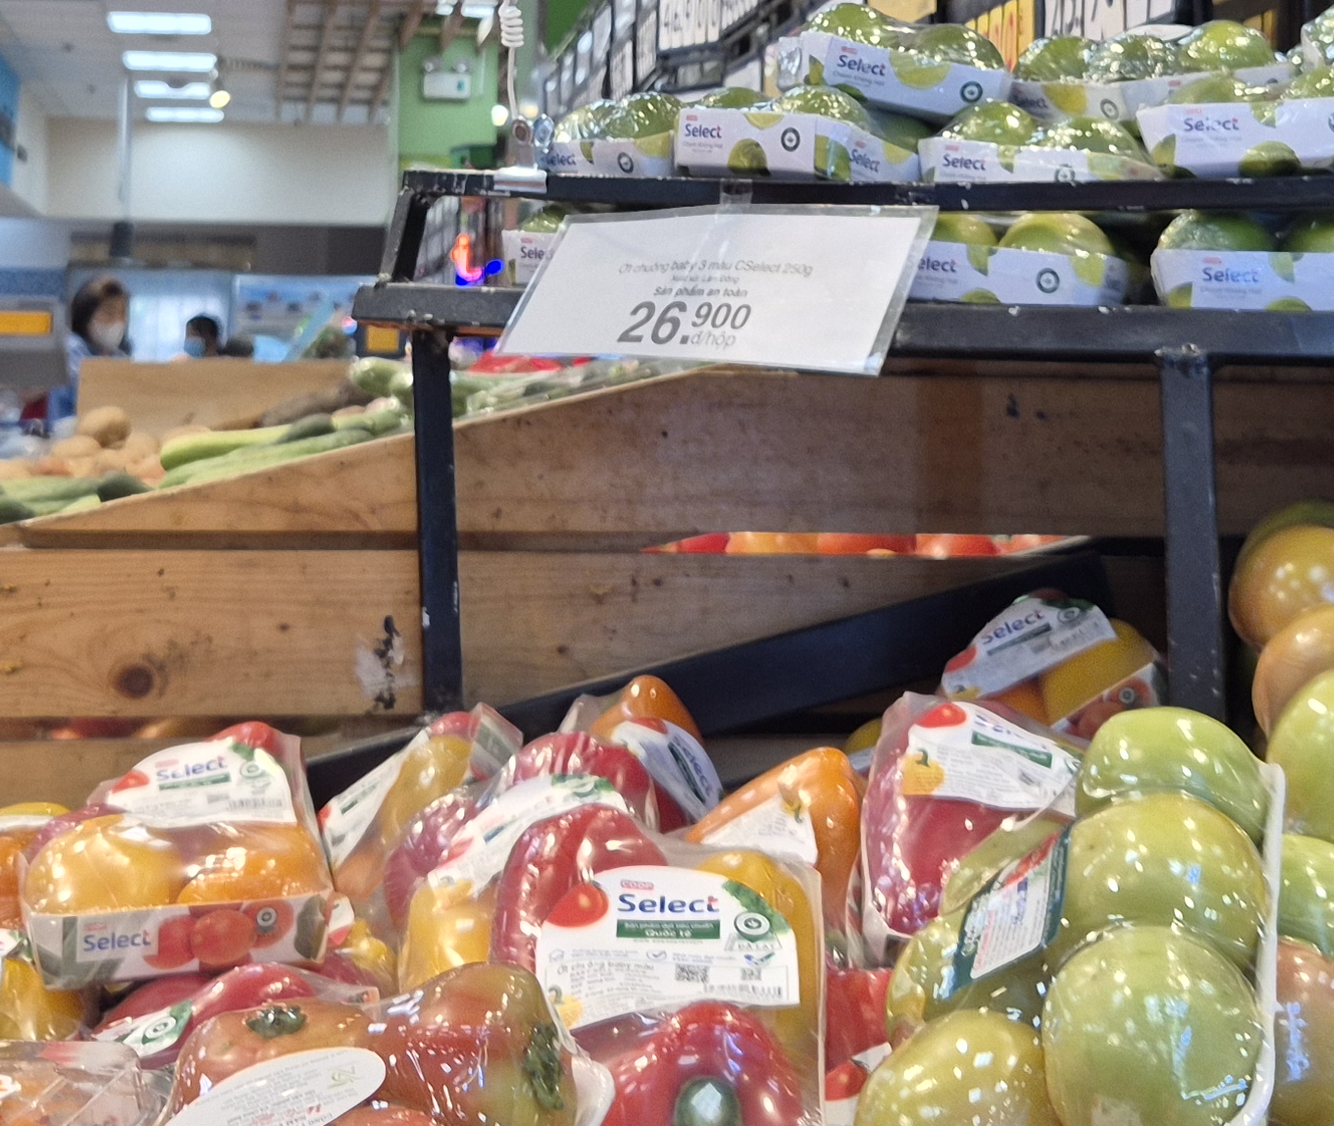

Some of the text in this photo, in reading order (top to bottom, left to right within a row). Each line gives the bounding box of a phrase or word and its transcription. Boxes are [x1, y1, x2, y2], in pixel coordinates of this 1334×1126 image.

[837, 53, 887, 78] Select
[683, 123, 723, 140] Select
[941, 152, 988, 172] Select
[1201, 265, 1260, 284] Select
[616, 300, 752, 346] 26.900
[616, 892, 721, 915] Select
[82, 929, 152, 954] Select
